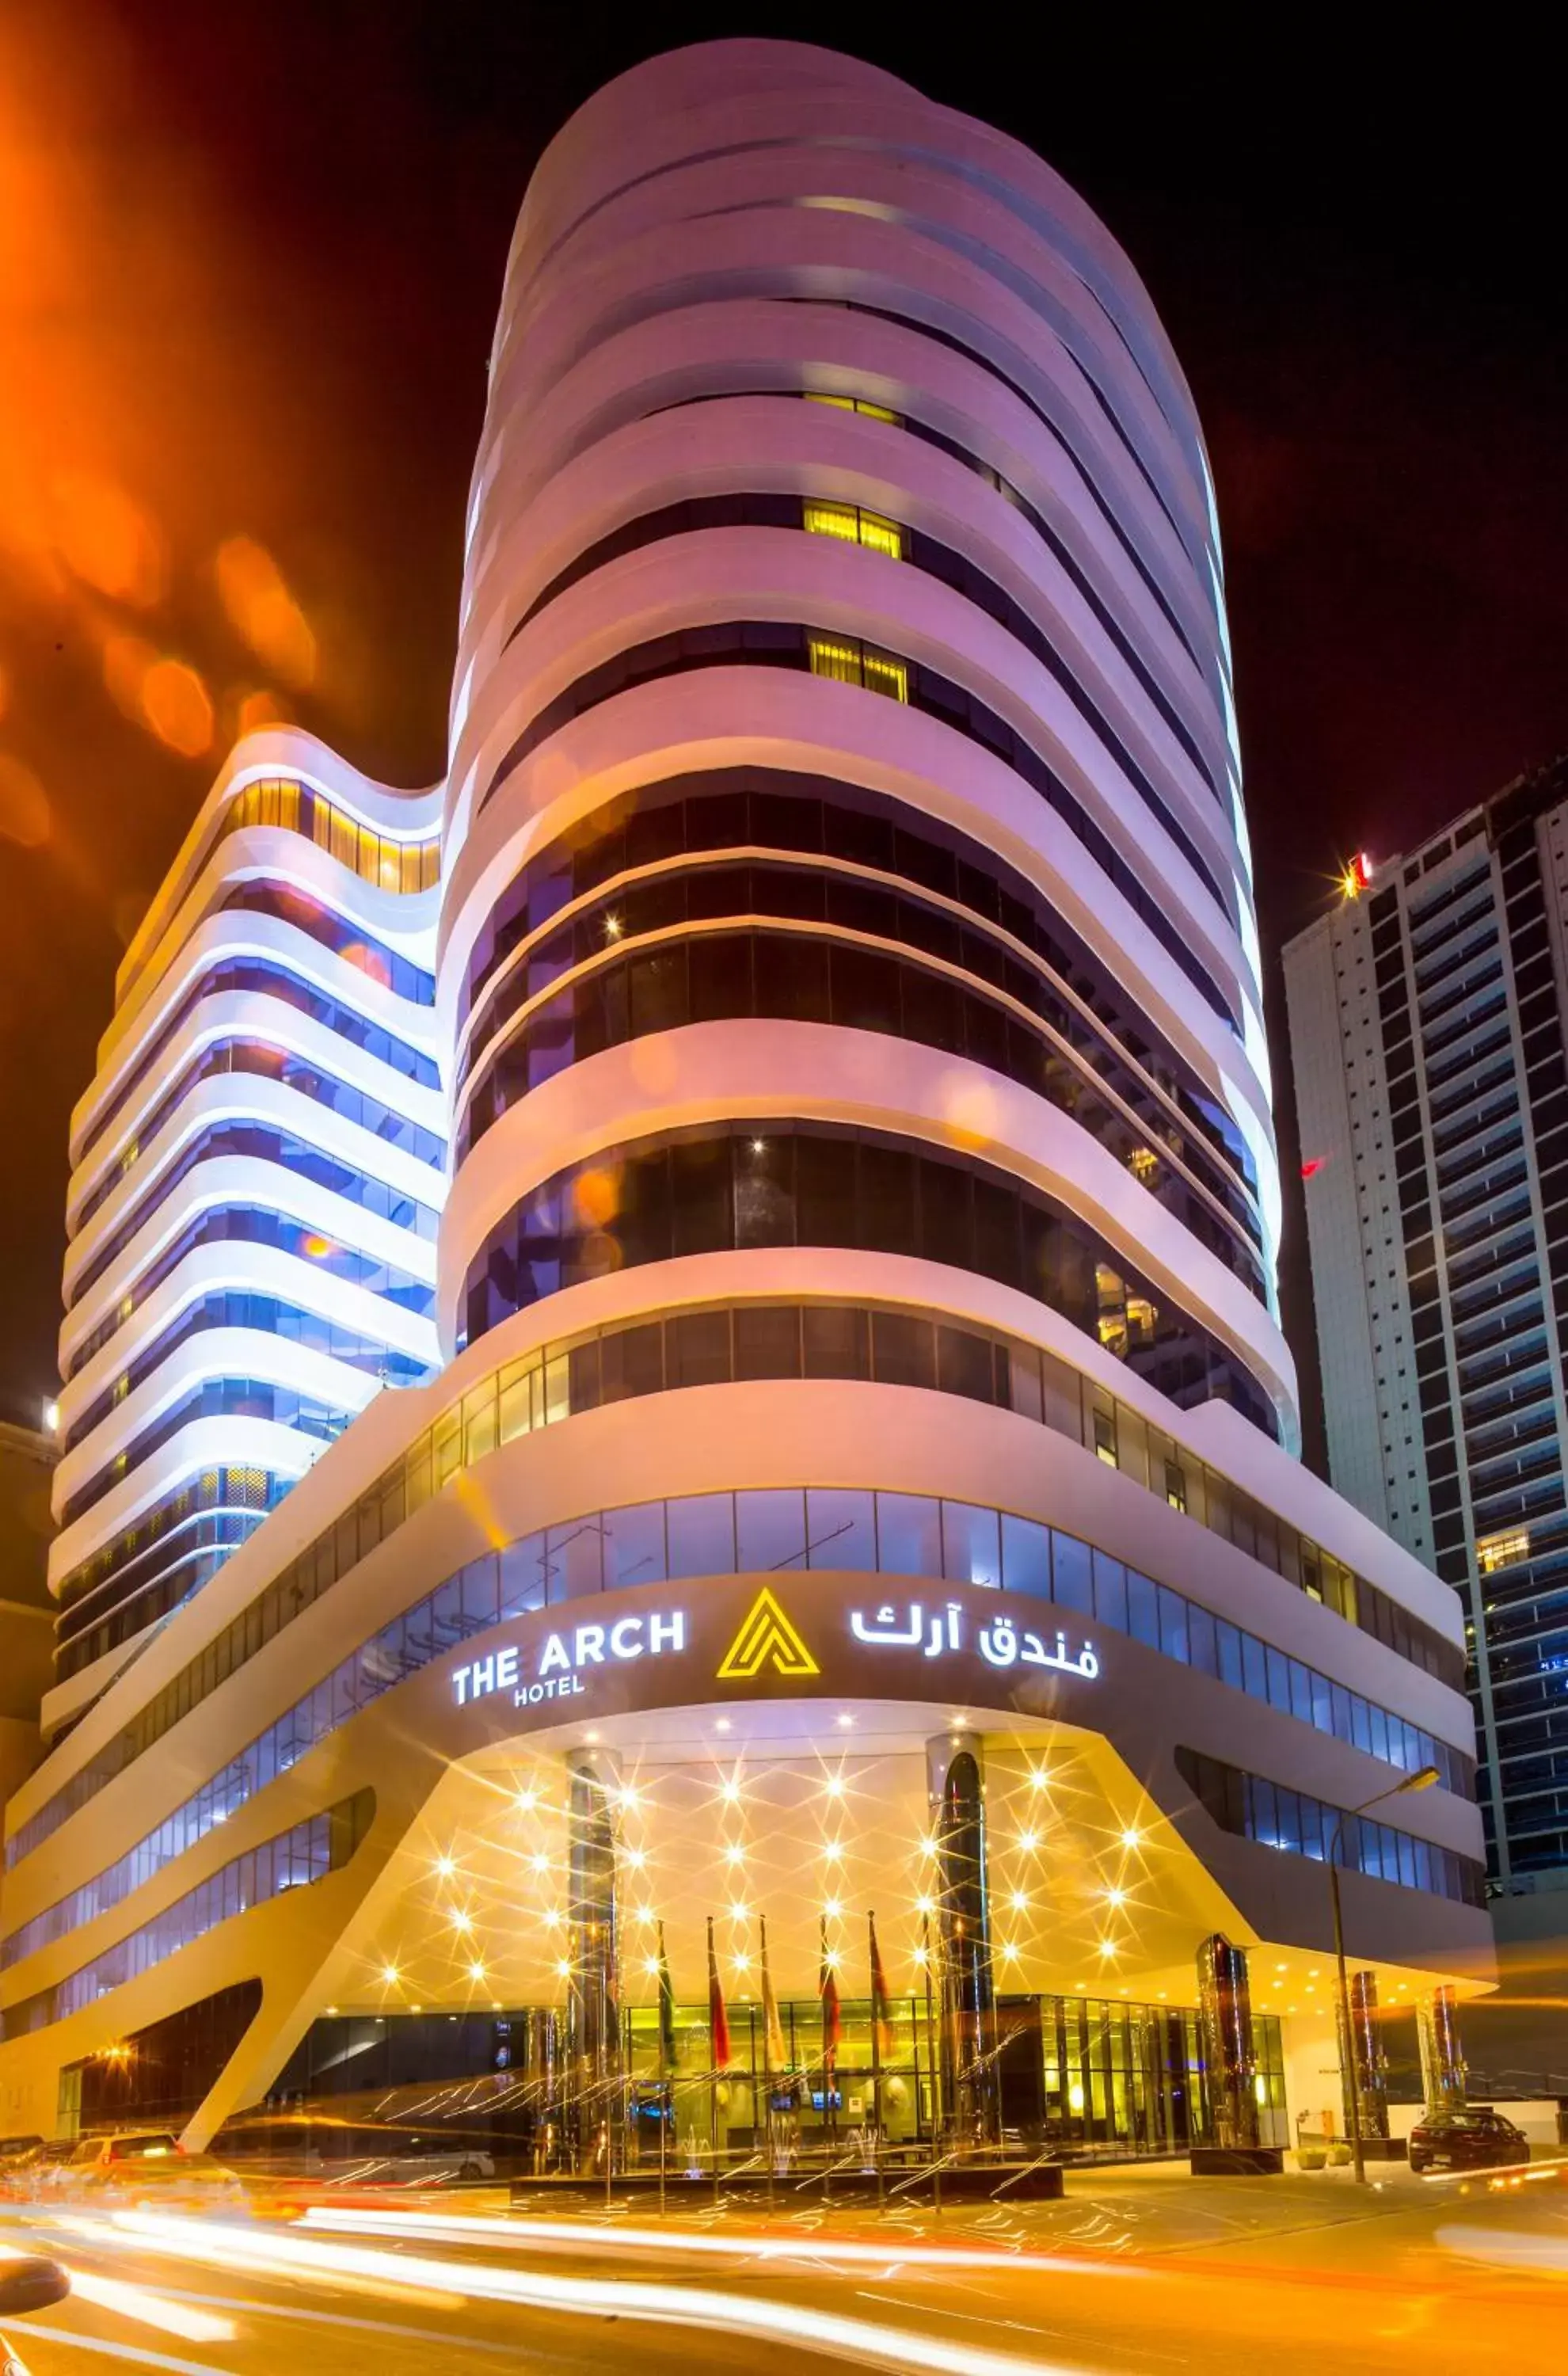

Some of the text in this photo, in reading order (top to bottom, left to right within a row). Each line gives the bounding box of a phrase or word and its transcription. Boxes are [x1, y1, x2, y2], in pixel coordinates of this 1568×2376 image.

[452, 1611, 683, 1705] THE ARCH
[851, 1602, 1099, 1680] فندق آرك
[515, 1674, 585, 1708] HOTEL
